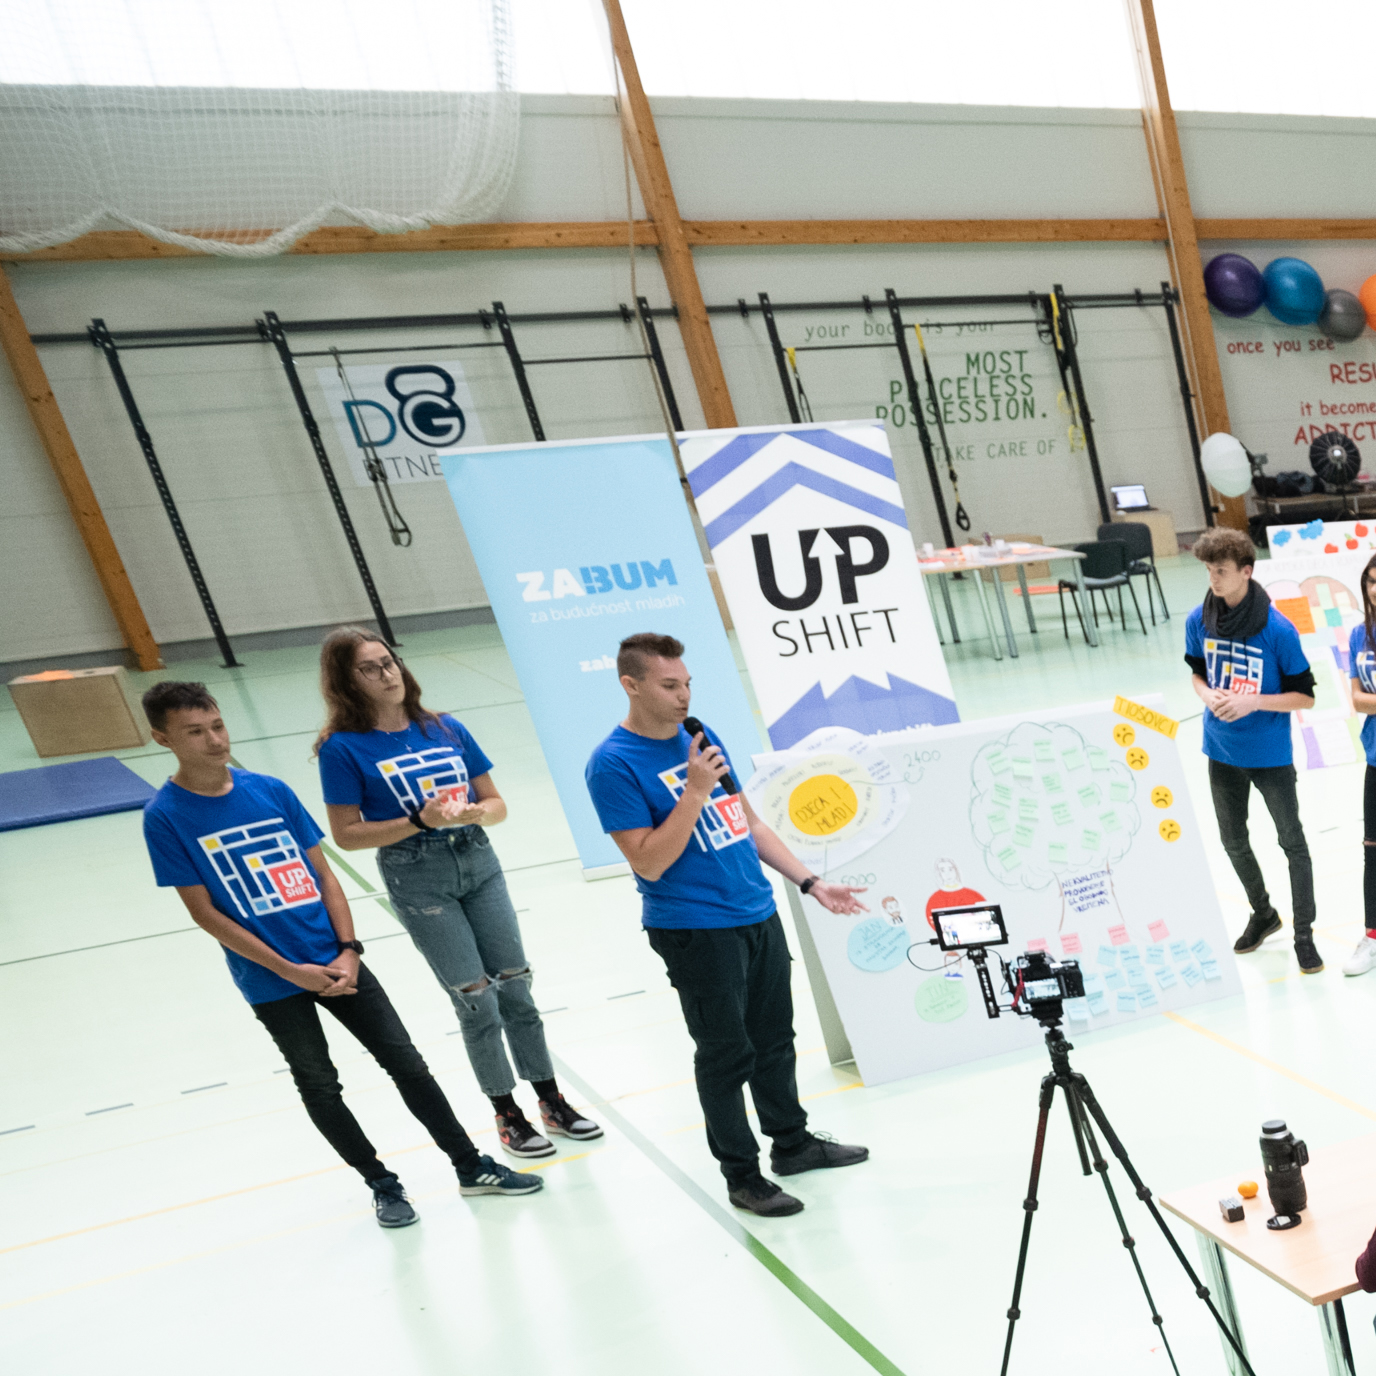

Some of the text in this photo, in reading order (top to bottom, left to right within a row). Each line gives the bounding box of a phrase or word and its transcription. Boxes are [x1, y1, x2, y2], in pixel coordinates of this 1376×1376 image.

[804, 324, 850, 341] your
[1227, 338, 1335, 357] once you see
[965, 351, 1028, 375] MOST
[1300, 402, 1313, 417] it
[987, 441, 1028, 459] CARE
[1037, 439, 1057, 456] OF
[751, 524, 890, 611] UP
[516, 558, 678, 602] ZABUM
[530, 594, 686, 624] za budućnost mladih
[772, 608, 898, 657] SHIFT
[903, 749, 941, 767] 2400
[795, 796, 830, 823] DJECA
[815, 802, 854, 833] MLADI
[278, 867, 306, 888] UP
[285, 882, 312, 898] SHIFT
[858, 921, 882, 938] JAN
